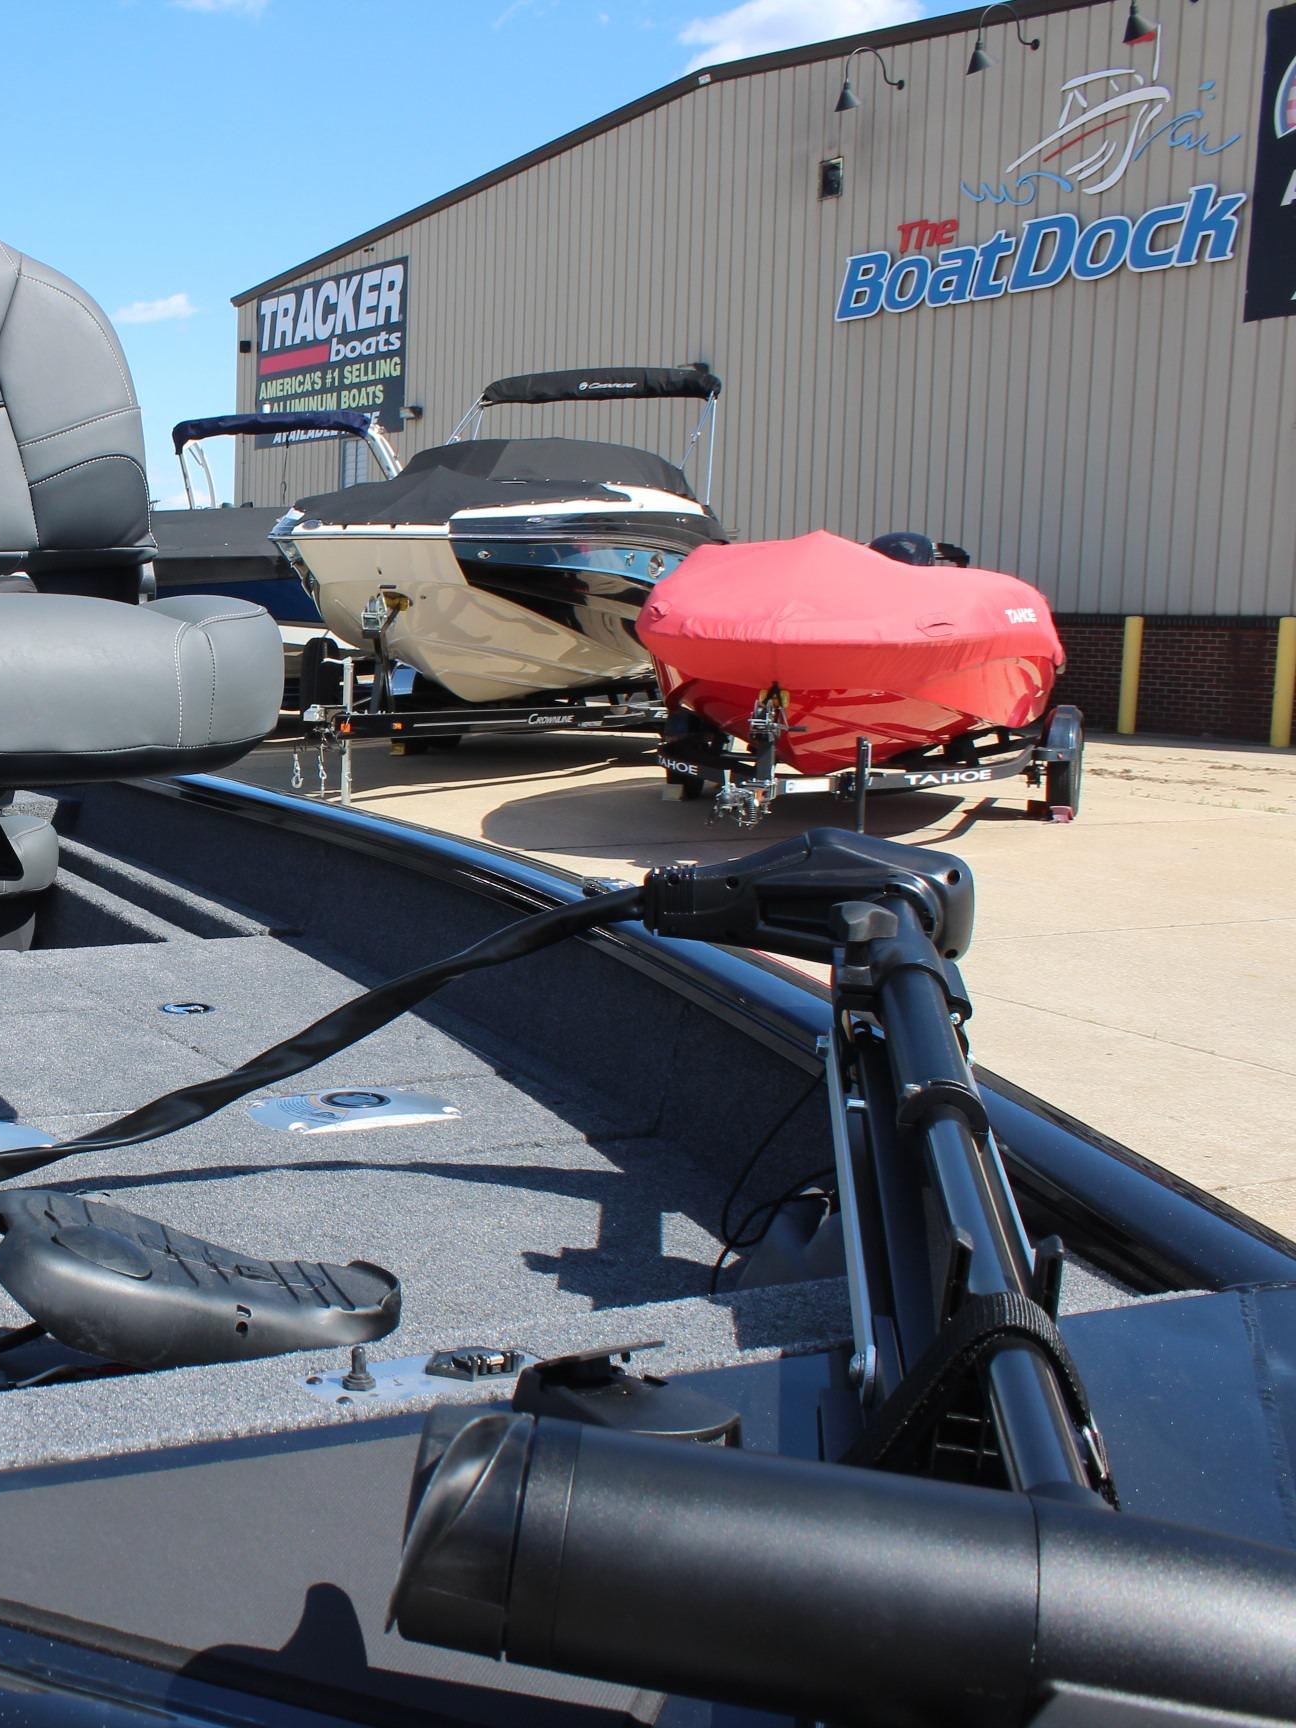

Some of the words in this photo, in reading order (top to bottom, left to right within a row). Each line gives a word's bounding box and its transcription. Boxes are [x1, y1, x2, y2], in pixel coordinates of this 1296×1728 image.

[897, 218, 959, 253] The
[260, 264, 404, 352] TRACKER
[330, 331, 401, 363] boats
[259, 371, 322, 400] AMERICA'S
[325, 367, 340, 388] #1
[343, 356, 401, 385] SELLING
[340, 384, 384, 410] BOATS
[658, 754, 699, 776] TAHOE
[904, 768, 992, 786] TAHOE
